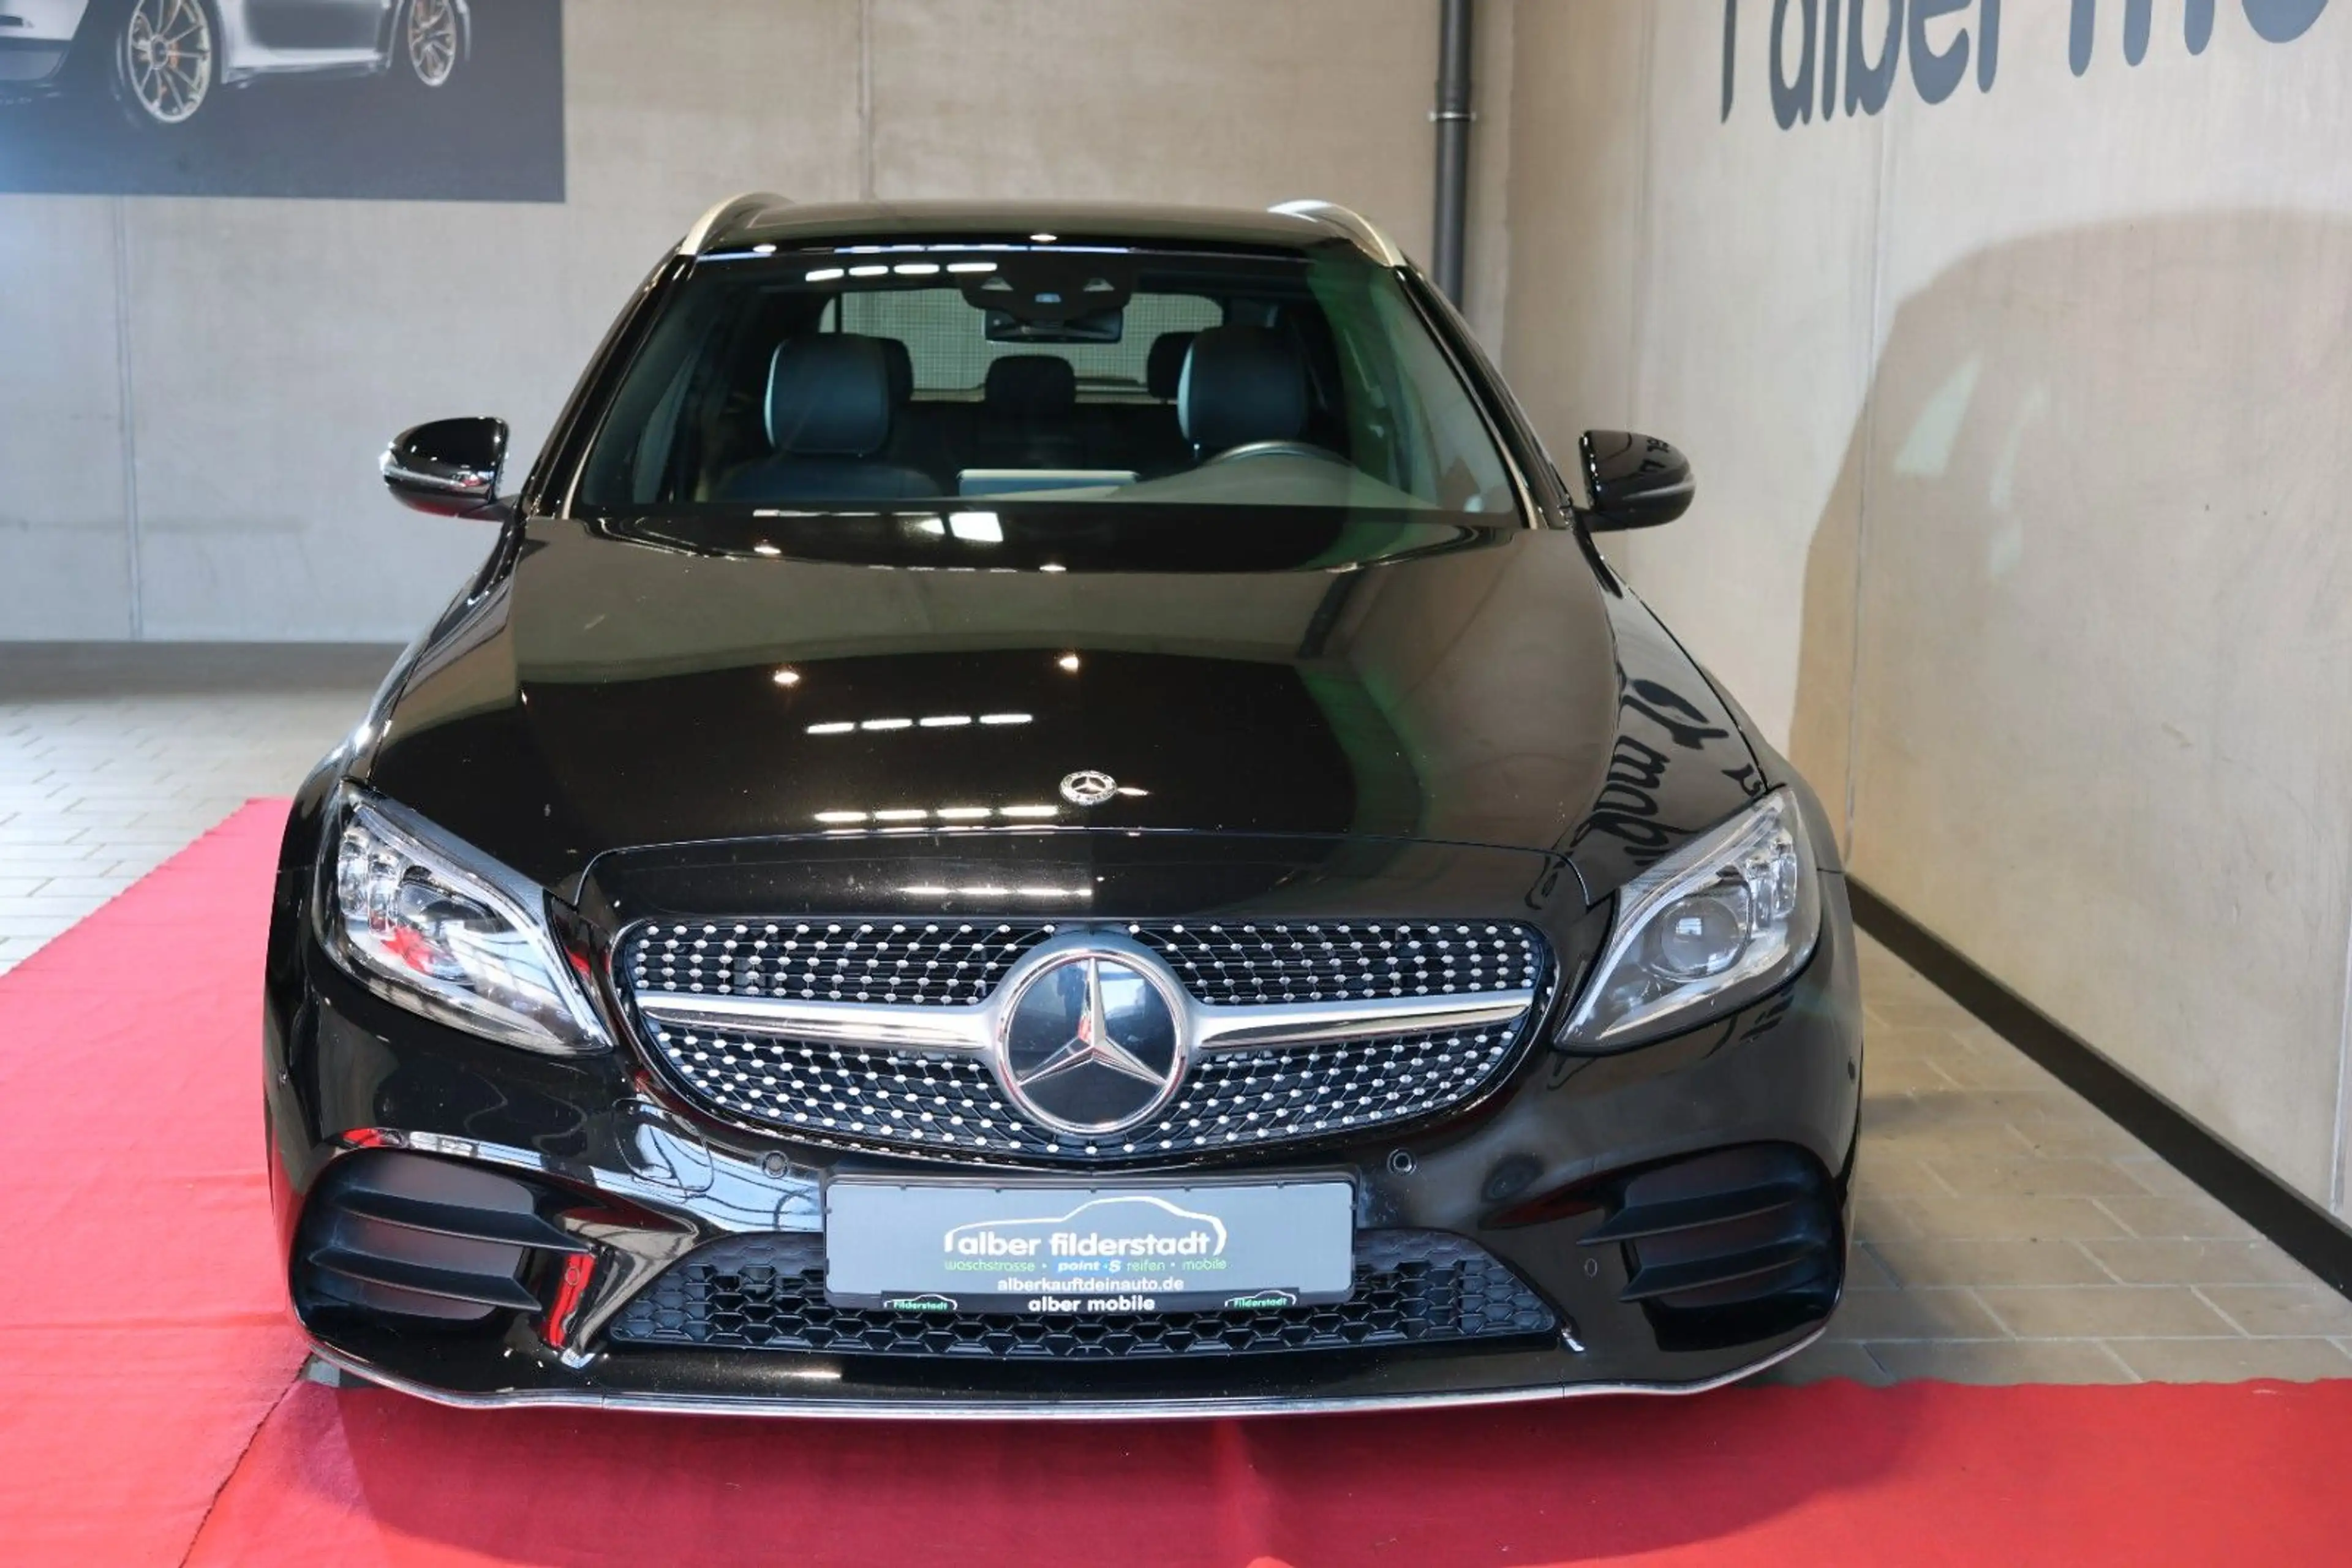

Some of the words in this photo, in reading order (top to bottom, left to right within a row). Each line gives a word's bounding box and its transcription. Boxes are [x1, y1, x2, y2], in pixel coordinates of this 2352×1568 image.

[958, 1231, 1041, 1256] alber
[1049, 1231, 1210, 1256] filderstadt
[944, 1259, 1036, 1272] waschstrasse
[1127, 1259, 1165, 1272] reifen
[1183, 1259, 1227, 1271] mobile
[997, 1276, 1185, 1292] alberkauftdeinauto.de
[1028, 1296, 1082, 1312] alber
[1087, 1295, 1155, 1311] mobile
